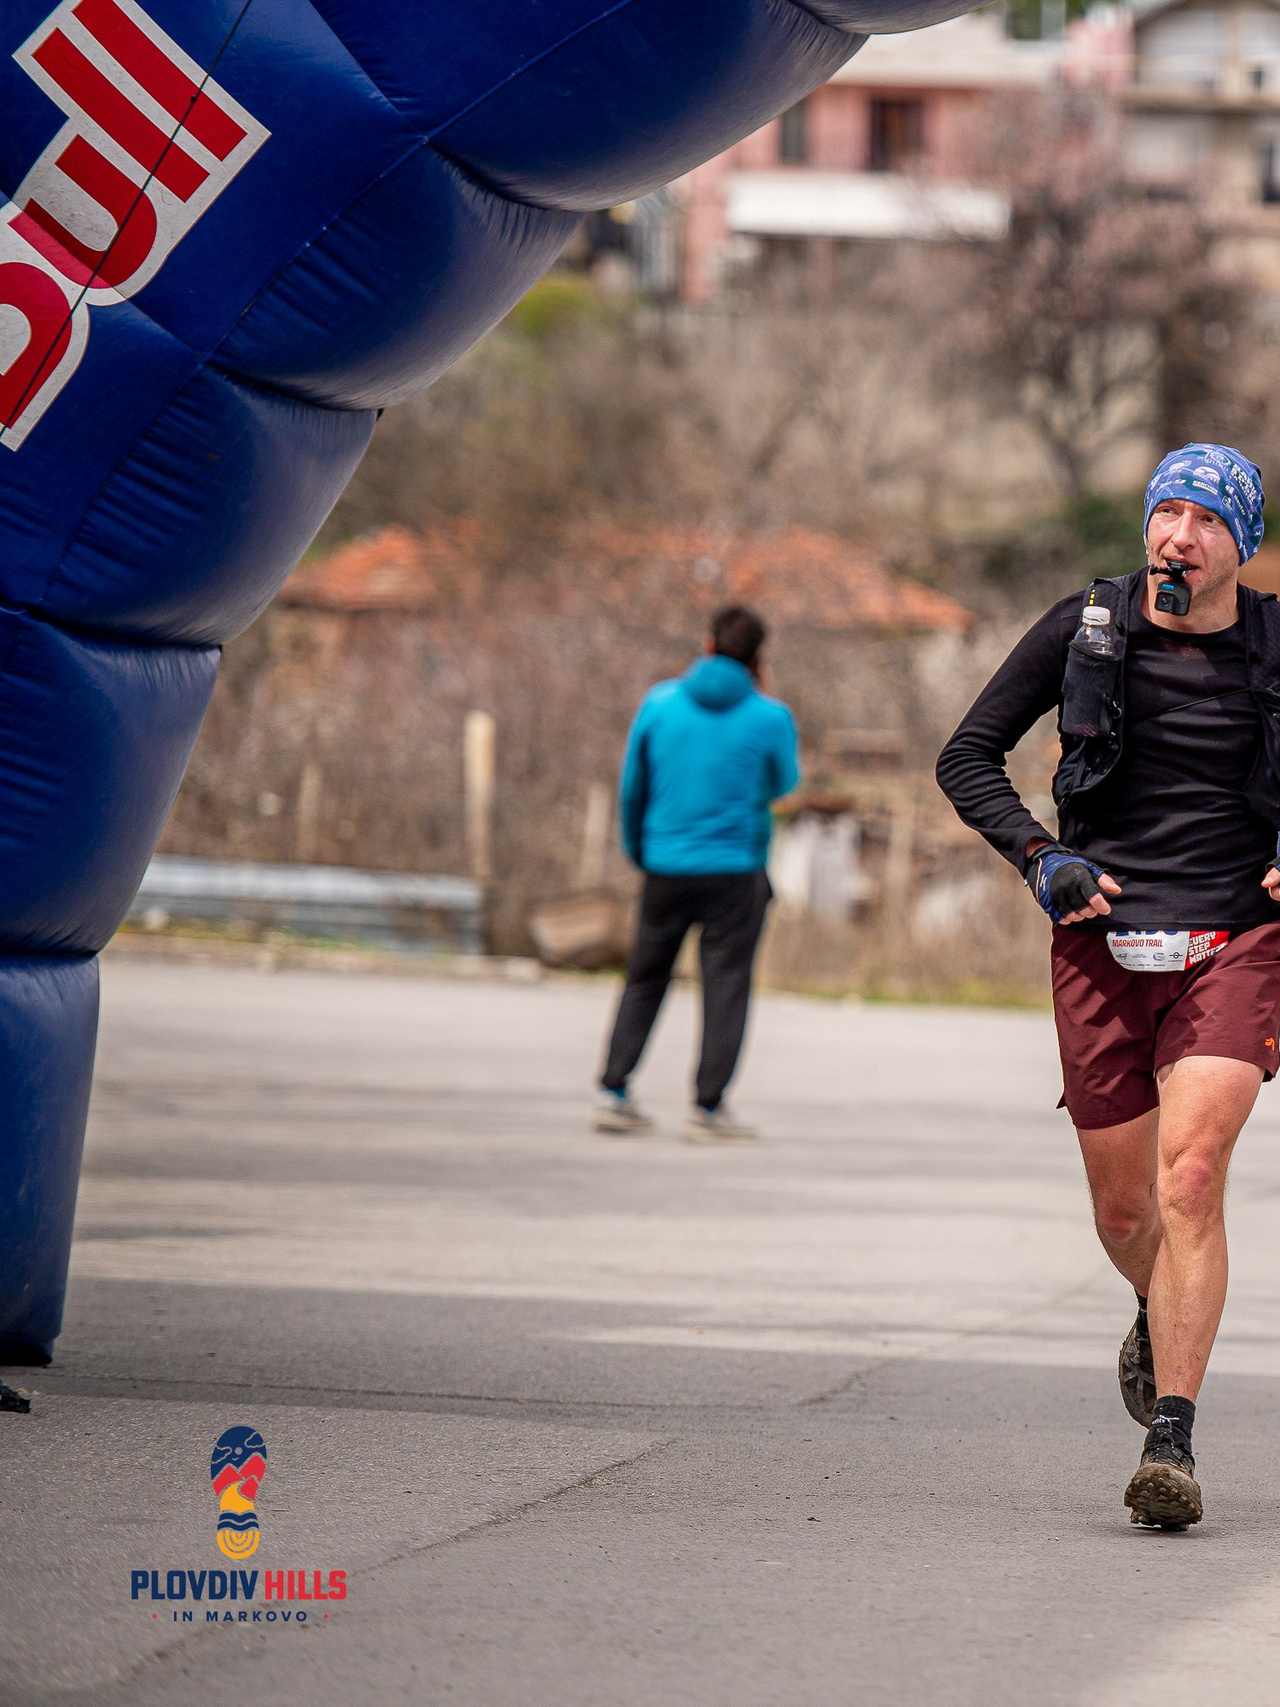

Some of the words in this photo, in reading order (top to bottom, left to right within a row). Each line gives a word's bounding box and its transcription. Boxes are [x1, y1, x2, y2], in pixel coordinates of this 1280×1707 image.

[1112, 939, 1145, 948] MARKOVO
[1145, 938, 1164, 948] TRAIL
[1188, 941, 1211, 956] STEP
